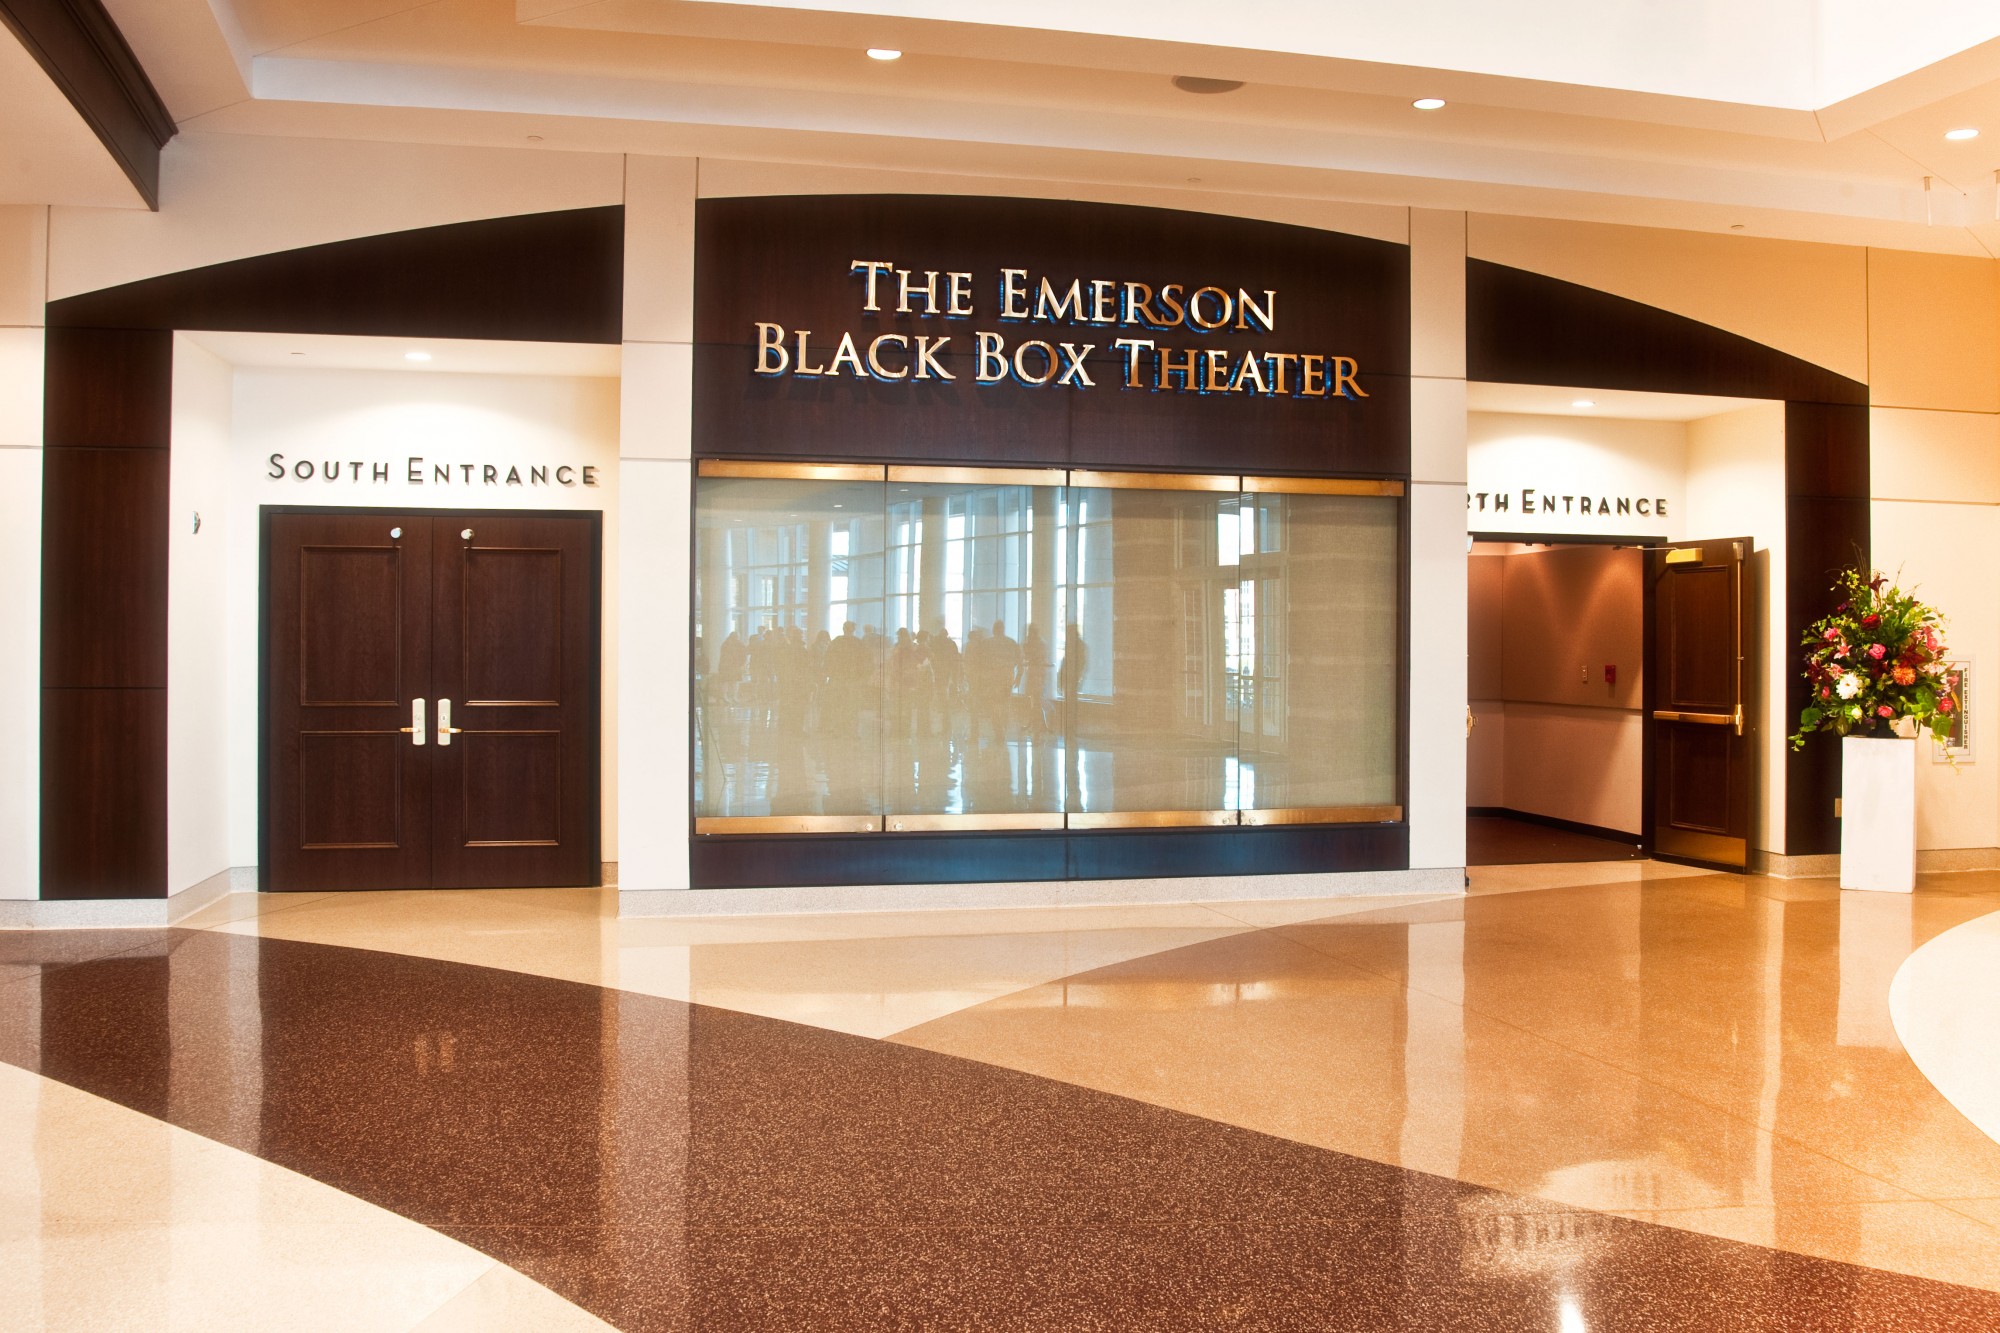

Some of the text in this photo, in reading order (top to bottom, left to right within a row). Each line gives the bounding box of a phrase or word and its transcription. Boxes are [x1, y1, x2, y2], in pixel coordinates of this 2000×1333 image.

[850, 259, 1277, 332] THE EMERSON
[753, 321, 1370, 399] BLACK BOX THEATER
[268, 453, 597, 486] SOUTH ENTRANCE
[1467, 489, 1667, 516] TH ENTRANCE
